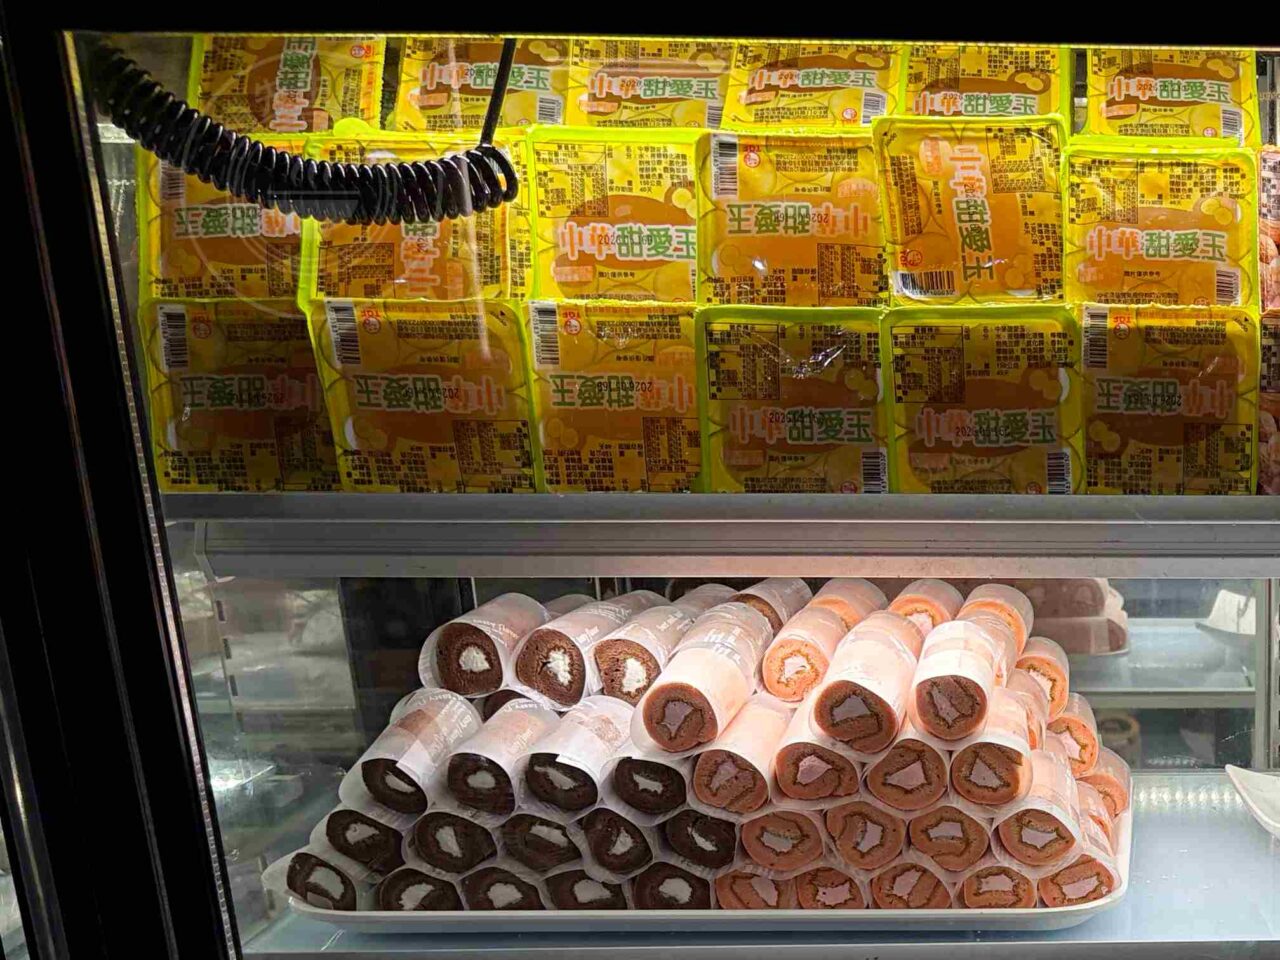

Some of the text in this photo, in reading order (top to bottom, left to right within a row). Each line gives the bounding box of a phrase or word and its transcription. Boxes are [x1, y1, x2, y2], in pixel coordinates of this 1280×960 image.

[589, 73, 718, 100] 中華甜愛玉
[750, 69, 876, 88] 中華甜愛玉
[1108, 76, 1231, 103] 中華甜愛玉
[914, 92, 1038, 115] 中華甜愛玉
[175, 204, 300, 239] 華甜愛玉
[727, 202, 870, 238] 中華甜愛玉
[950, 145, 994, 282] 中華甜愛玉
[559, 222, 696, 260] 中華甜愛玉
[1088, 226, 1226, 262] 中華甜愛玉
[354, 375, 505, 415] 中華甜愛玉
[550, 374, 693, 412] 中華甜愛玉
[1096, 378, 1233, 419] 中華甜愛玉
[729, 406, 873, 444] 中華甜愛玉
[916, 408, 1056, 448] 中華甜愛玉
